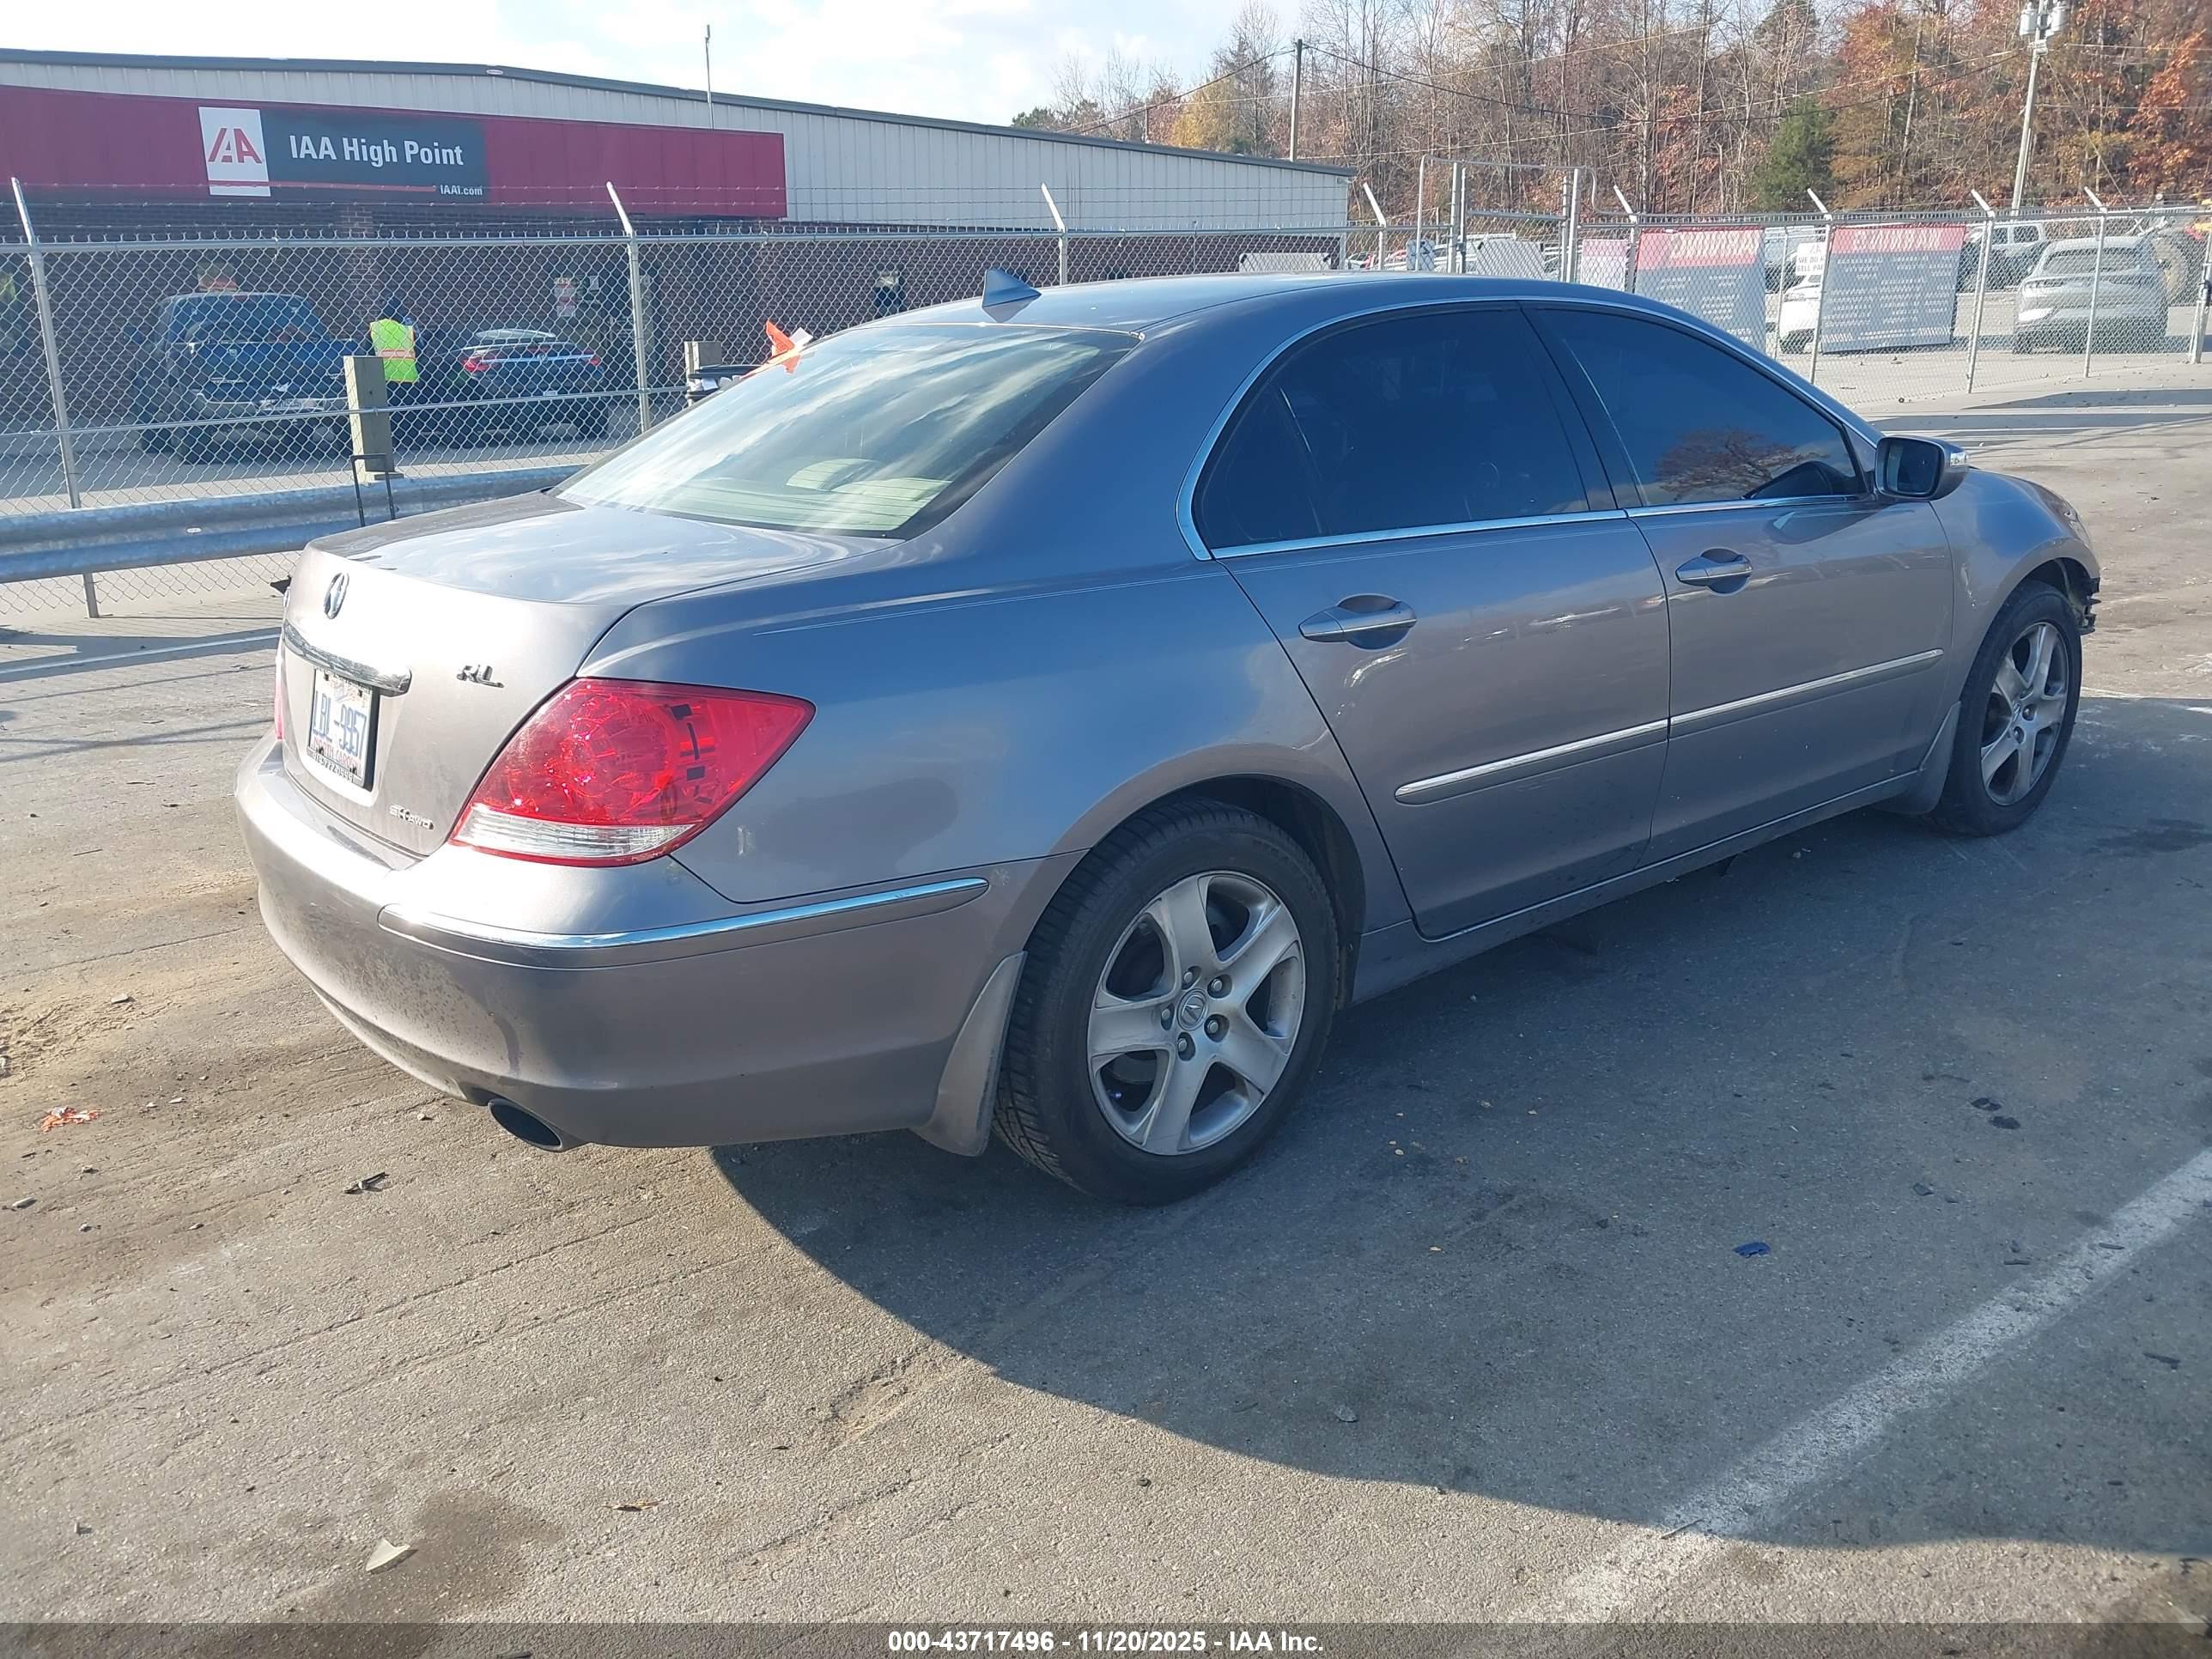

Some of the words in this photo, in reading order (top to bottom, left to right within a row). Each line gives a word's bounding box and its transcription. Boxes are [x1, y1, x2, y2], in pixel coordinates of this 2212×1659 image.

[289, 135, 337, 161] IAA
[343, 137, 398, 167] High
[404, 139, 464, 166] Point
[456, 664, 505, 689] RL
